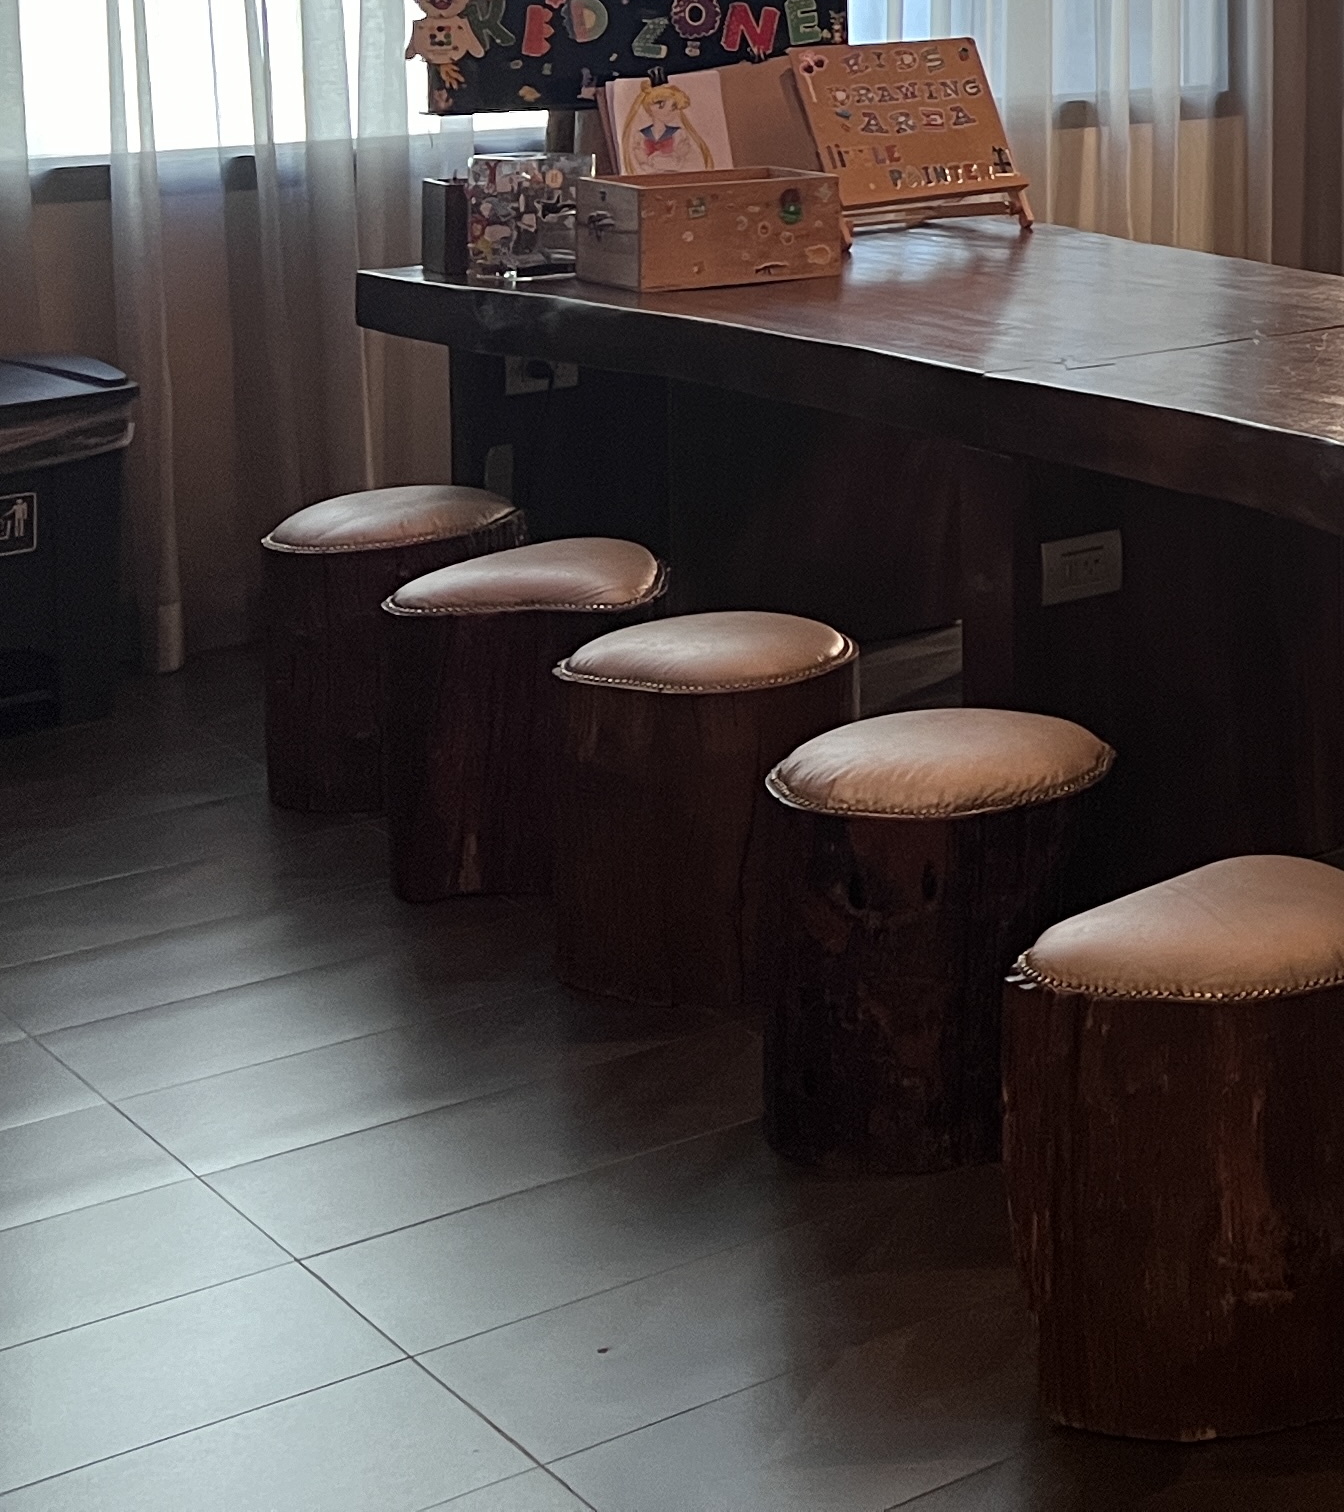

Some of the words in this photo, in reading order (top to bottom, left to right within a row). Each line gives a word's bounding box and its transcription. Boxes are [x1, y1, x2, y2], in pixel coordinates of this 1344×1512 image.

[841, 44, 946, 80] KIDS
[826, 78, 984, 108] DRAWING
[859, 105, 978, 135] AREA
